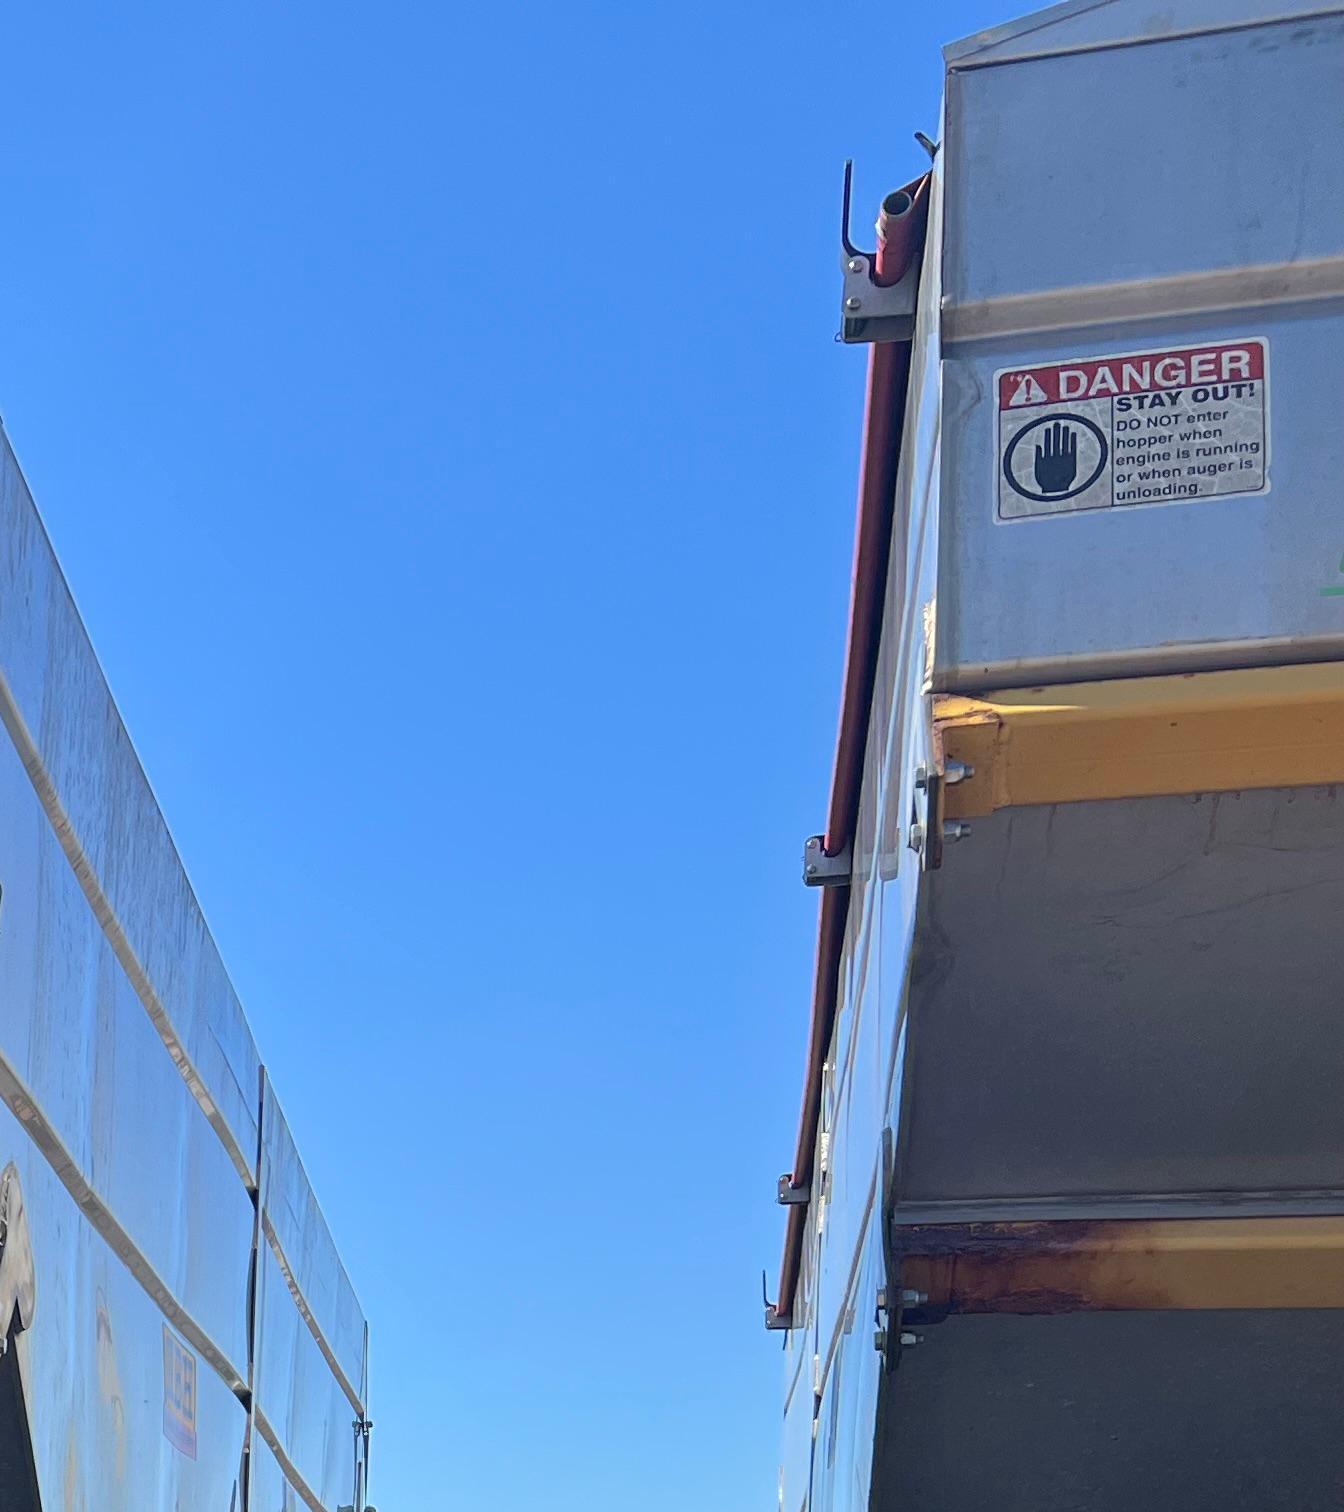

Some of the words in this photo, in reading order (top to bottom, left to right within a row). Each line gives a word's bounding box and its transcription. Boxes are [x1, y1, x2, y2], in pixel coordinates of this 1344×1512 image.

[1058, 349, 1251, 400] DANGER
[1116, 390, 1183, 412] STAY
[1191, 382, 1256, 403] OUT!
[1116, 418, 1141, 432] DO
[1146, 414, 1182, 428] NOT
[1186, 410, 1229, 424] enter
[1116, 434, 1174, 449] hopper
[1179, 428, 1222, 441] when
[1115, 450, 1171, 467] engine
[1176, 448, 1190, 459] is
[1195, 441, 1260, 457] running
[1116, 472, 1133, 483] or
[1137, 467, 1182, 481] when
[1186, 462, 1234, 476] auger
[1239, 458, 1253, 470] is
[1116, 483, 1203, 501] unloading.
